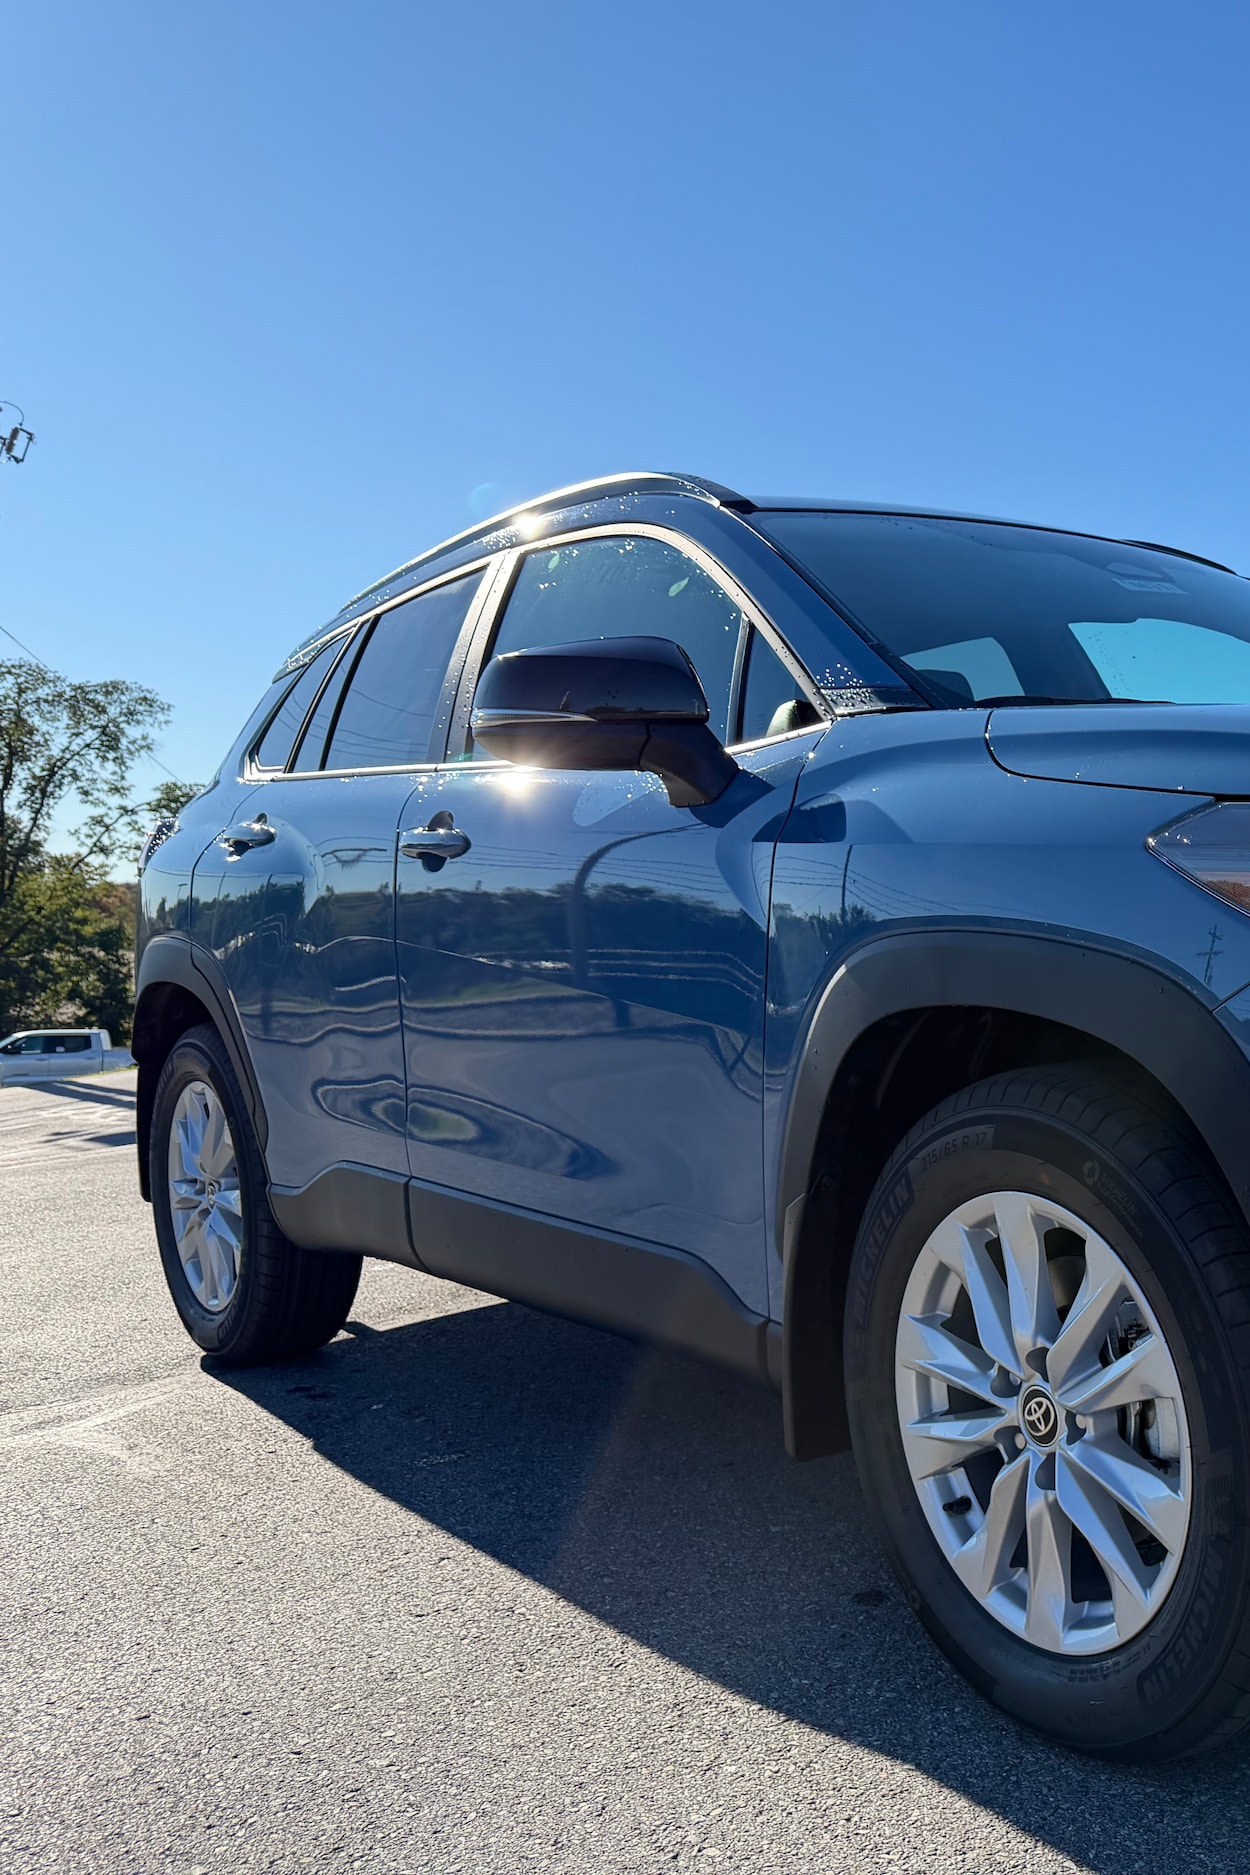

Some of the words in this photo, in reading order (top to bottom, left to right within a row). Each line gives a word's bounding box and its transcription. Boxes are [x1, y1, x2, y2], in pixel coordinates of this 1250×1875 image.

[920, 1138, 958, 1172] 215/65
[853, 1176, 911, 1326] MICHELIN
[1143, 1543, 1225, 1705] MICHELIN
